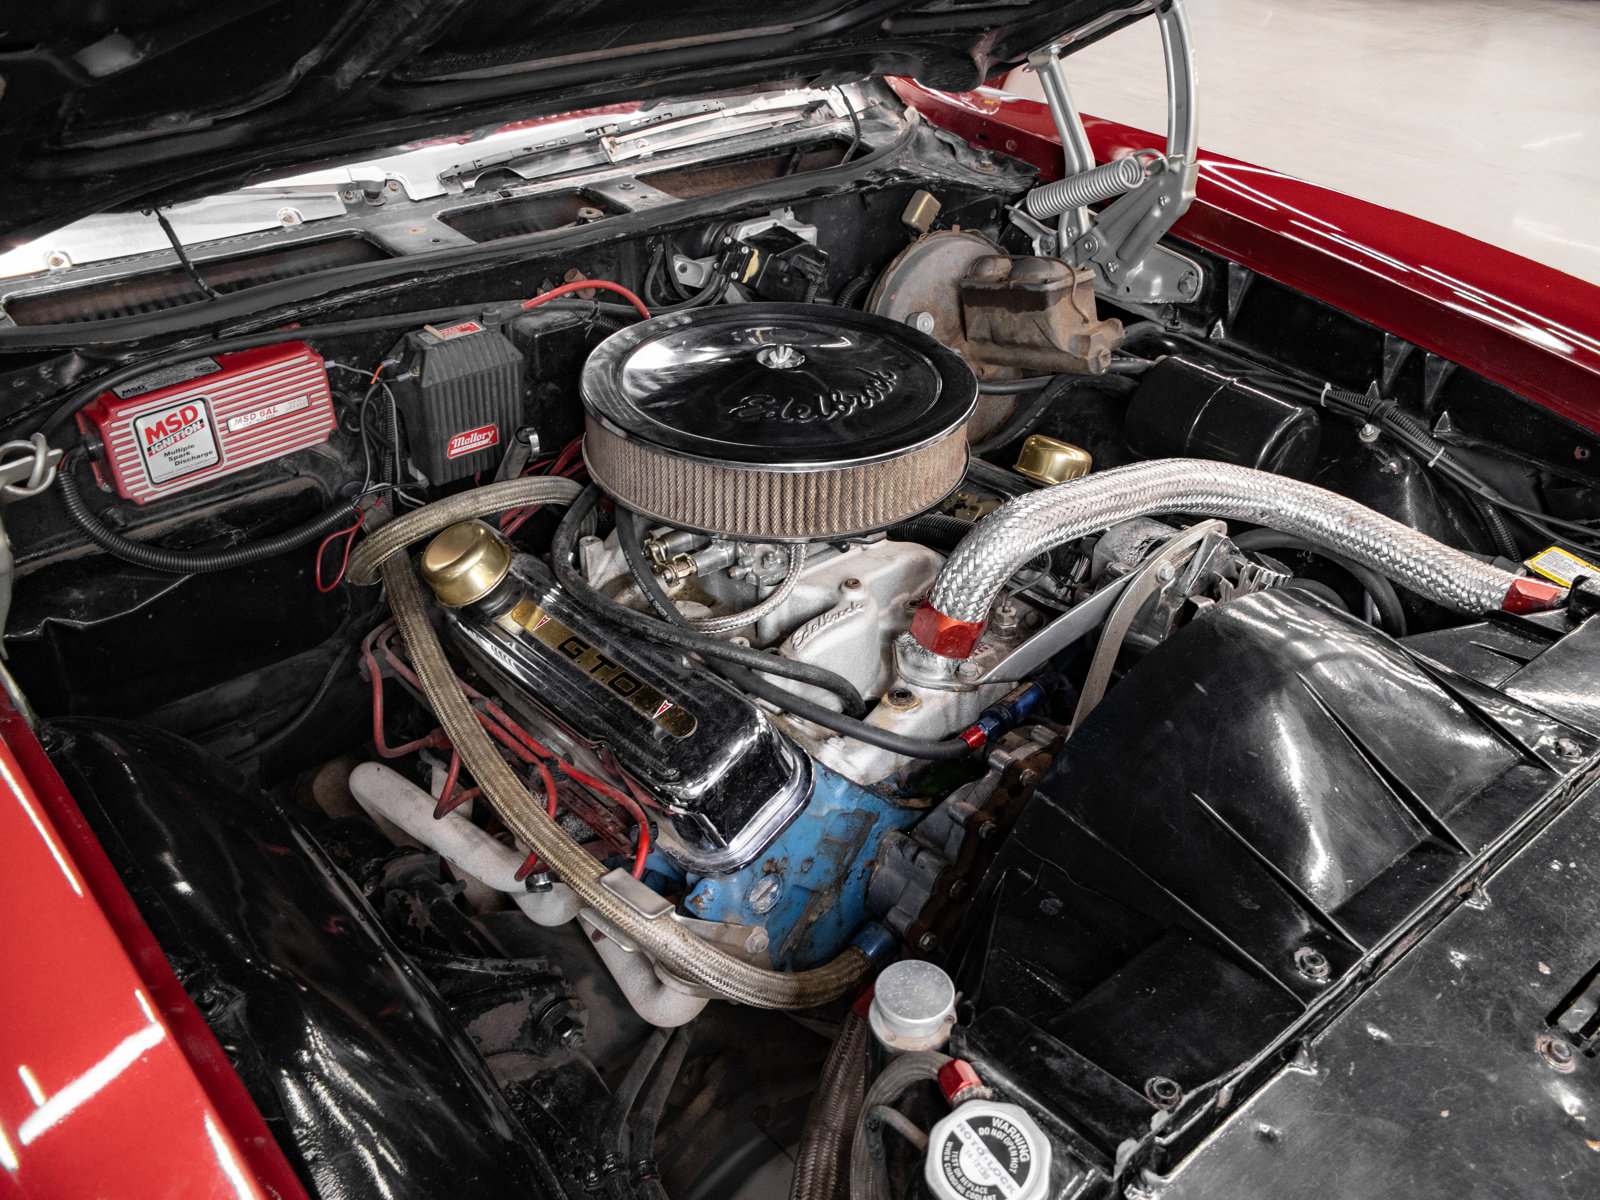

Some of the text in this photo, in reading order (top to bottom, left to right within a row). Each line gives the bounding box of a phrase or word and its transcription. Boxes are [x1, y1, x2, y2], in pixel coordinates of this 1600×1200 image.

[122, 385, 144, 397] MSD
[144, 405, 198, 445] MSD
[234, 413, 257, 426] MSD
[259, 406, 278, 417] 6AL
[150, 420, 203, 455] IGNITION
[163, 444, 195, 457] Multiple
[451, 430, 494, 448] Mallory
[168, 451, 190, 461] Spark
[174, 450, 213, 466] Discharge
[978, 1127, 1019, 1174] DO NOT OPEN HOT
[992, 1117, 1030, 1162] WARNING
[943, 1141, 997, 1200] WHEN CHANGING COOLANT
[951, 1151, 988, 1194] TEST OR REPLACE
